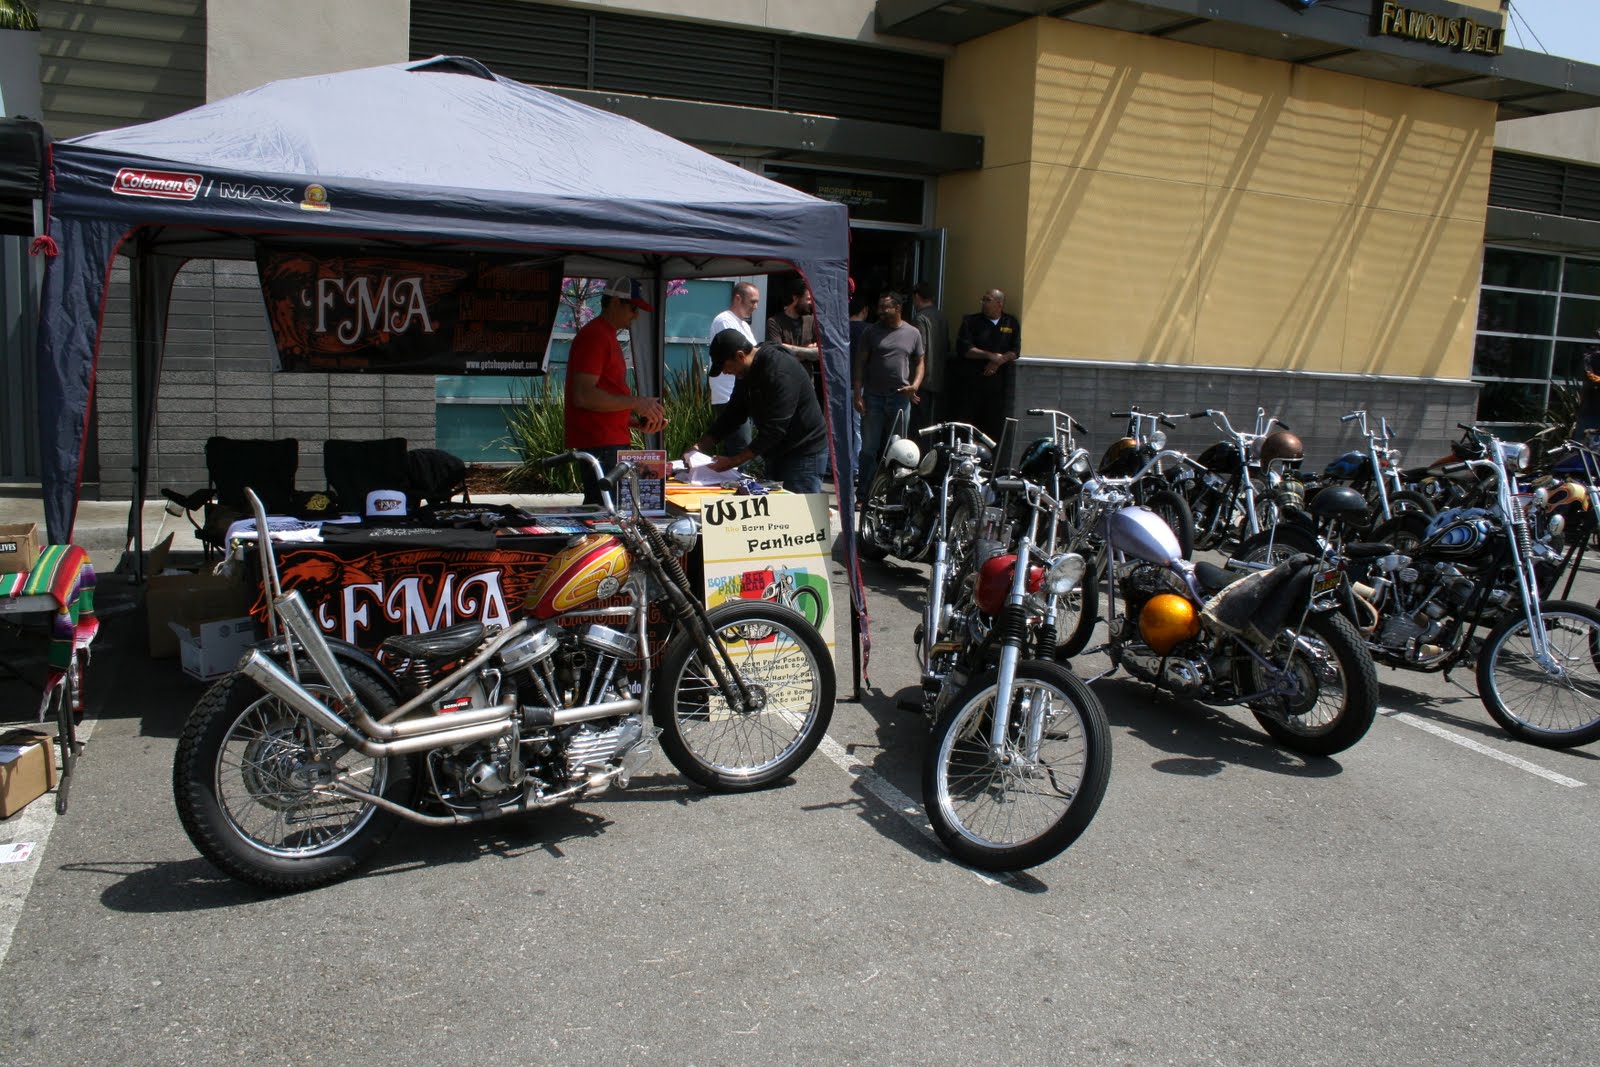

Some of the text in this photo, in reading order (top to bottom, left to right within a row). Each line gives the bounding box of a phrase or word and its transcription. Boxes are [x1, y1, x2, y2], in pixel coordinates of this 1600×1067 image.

[1381, 4, 1506, 55] FAMOUS DELI
[120, 172, 294, 203] Coleman MAX
[302, 276, 433, 345] FMA
[465, 359, 538, 371] www.getchoppedout.com
[768, 523, 790, 531] Free
[747, 528, 827, 553] Panhead
[707, 571, 765, 588] BORN FREE
[718, 582, 766, 595] PANHEAD
